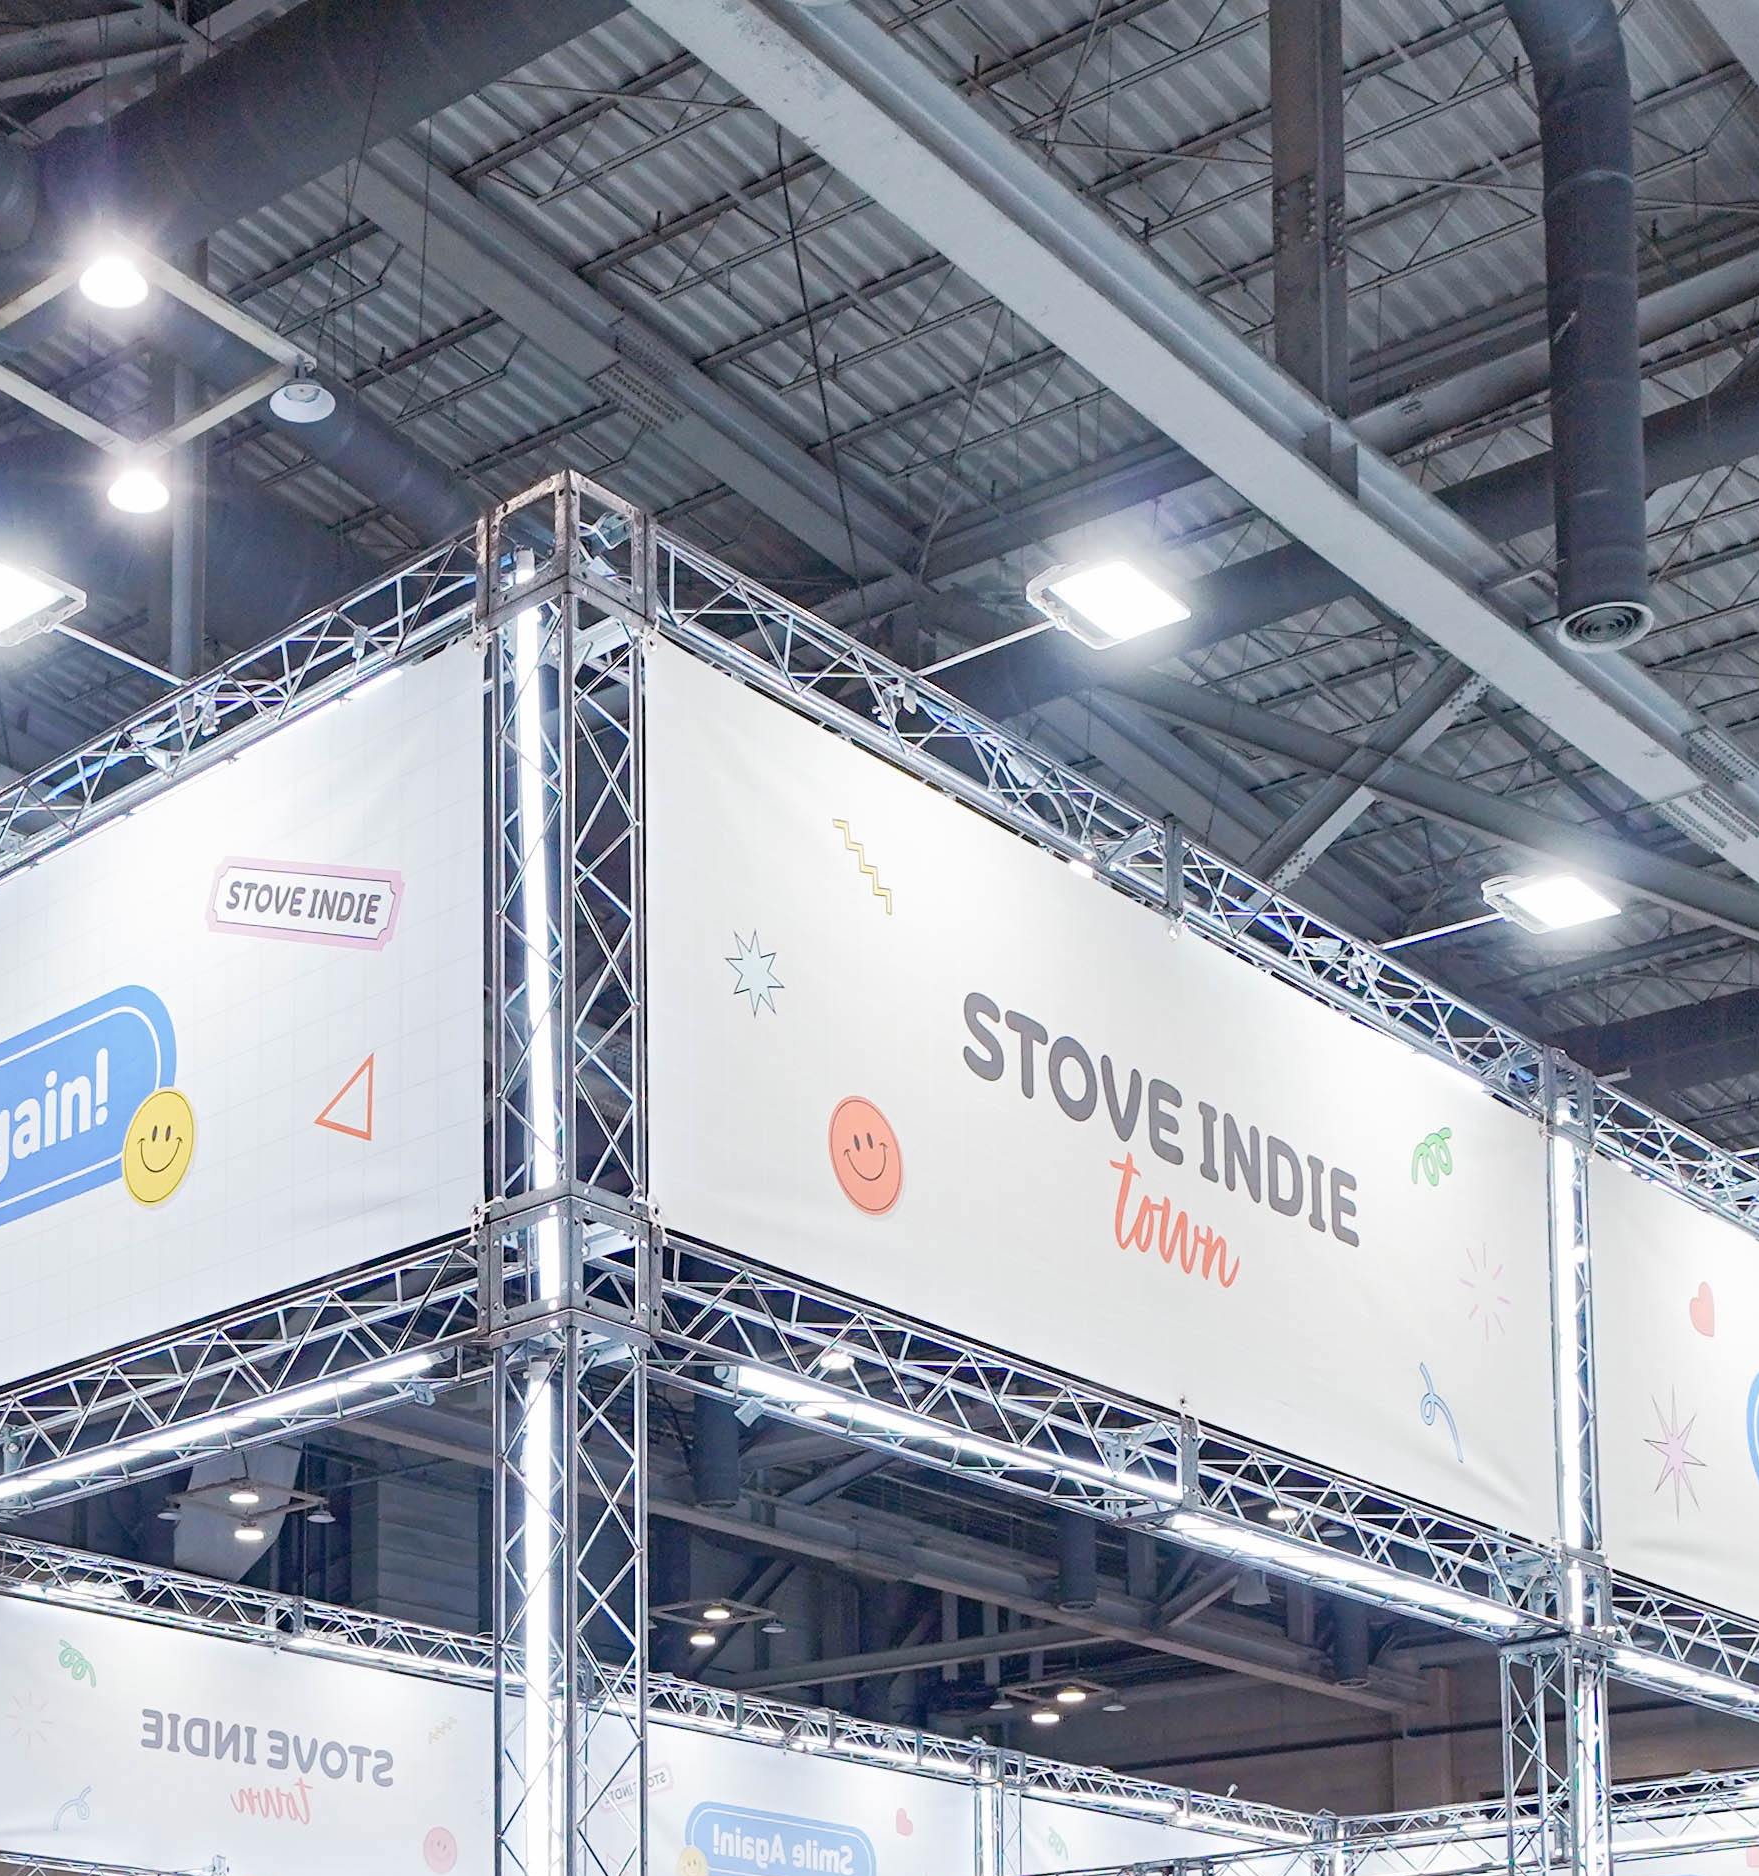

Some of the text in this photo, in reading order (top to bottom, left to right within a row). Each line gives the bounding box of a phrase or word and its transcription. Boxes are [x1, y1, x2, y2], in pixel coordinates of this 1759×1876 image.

[226, 880, 382, 925] STOVE INDIE
[963, 992, 1359, 1247] STOVE INDIE
[1110, 1152, 1240, 1288] town
